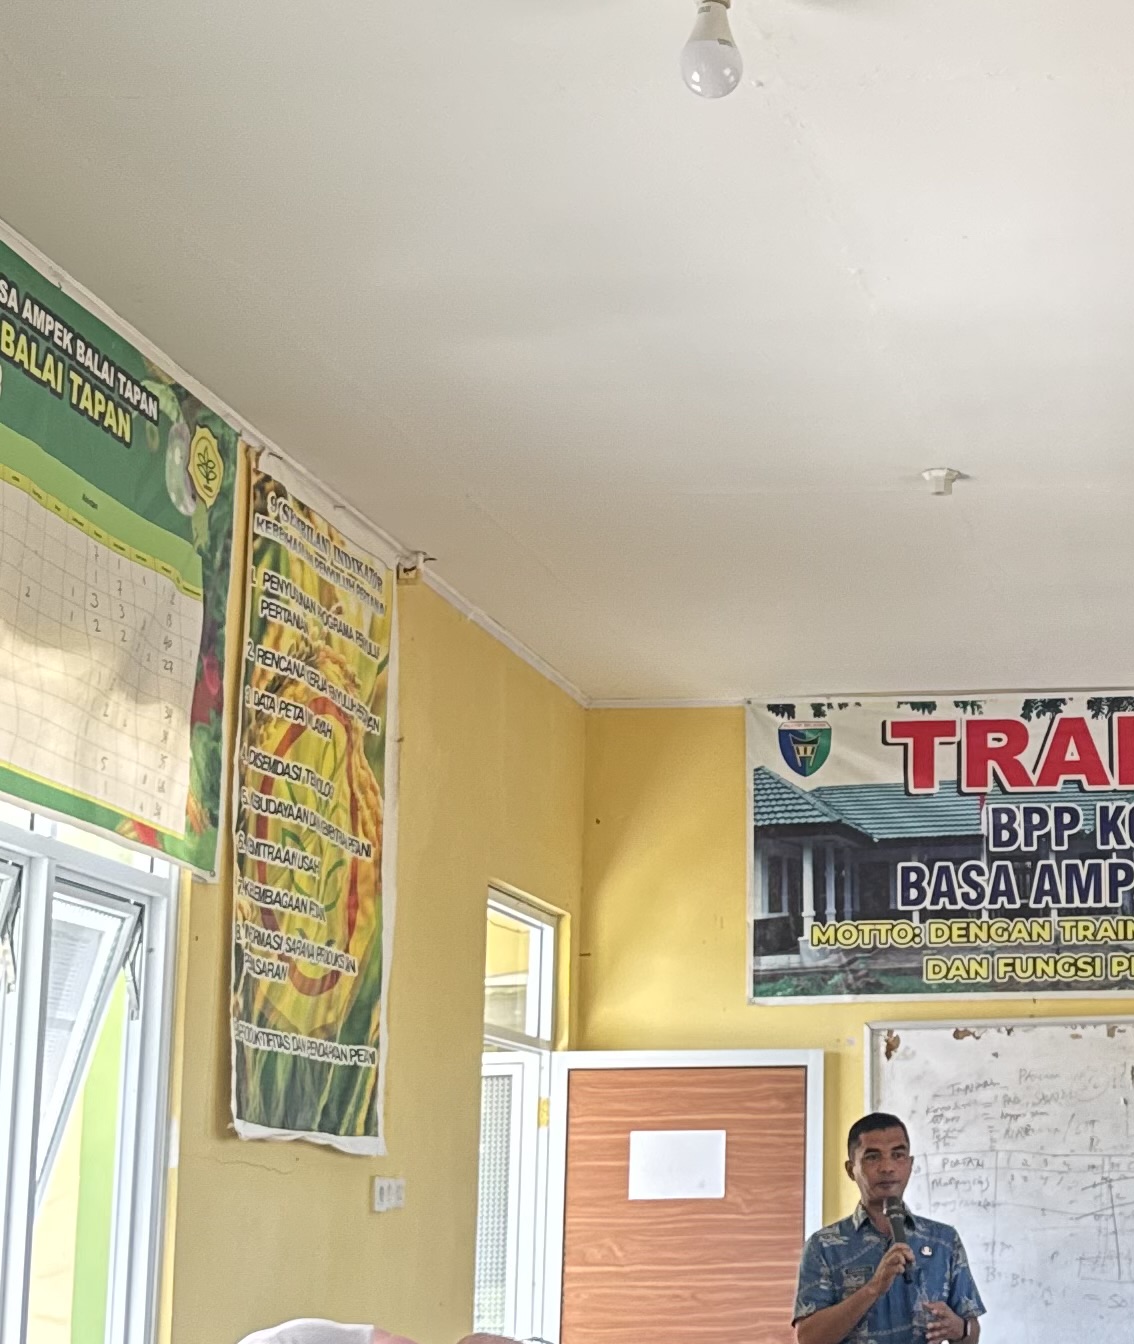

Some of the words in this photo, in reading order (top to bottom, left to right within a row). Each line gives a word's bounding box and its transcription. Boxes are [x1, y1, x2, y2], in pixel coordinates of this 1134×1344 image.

[22, 298, 74, 355] AMPEK
[76, 338, 115, 388] BALAI
[117, 371, 158, 422] TAPAN
[1, 320, 63, 394] BALAI
[69, 369, 131, 444] TAPAN
[257, 647, 305, 678] RENCANA
[254, 691, 276, 713] DATA
[280, 700, 304, 723] PETA
[990, 804, 1083, 850] BPP
[898, 861, 1020, 910] BASA
[809, 920, 924, 949] MOTTO:
[925, 916, 1053, 947] DENGAN
[923, 955, 992, 983] DAN
[996, 952, 1104, 981] FUNGSI
